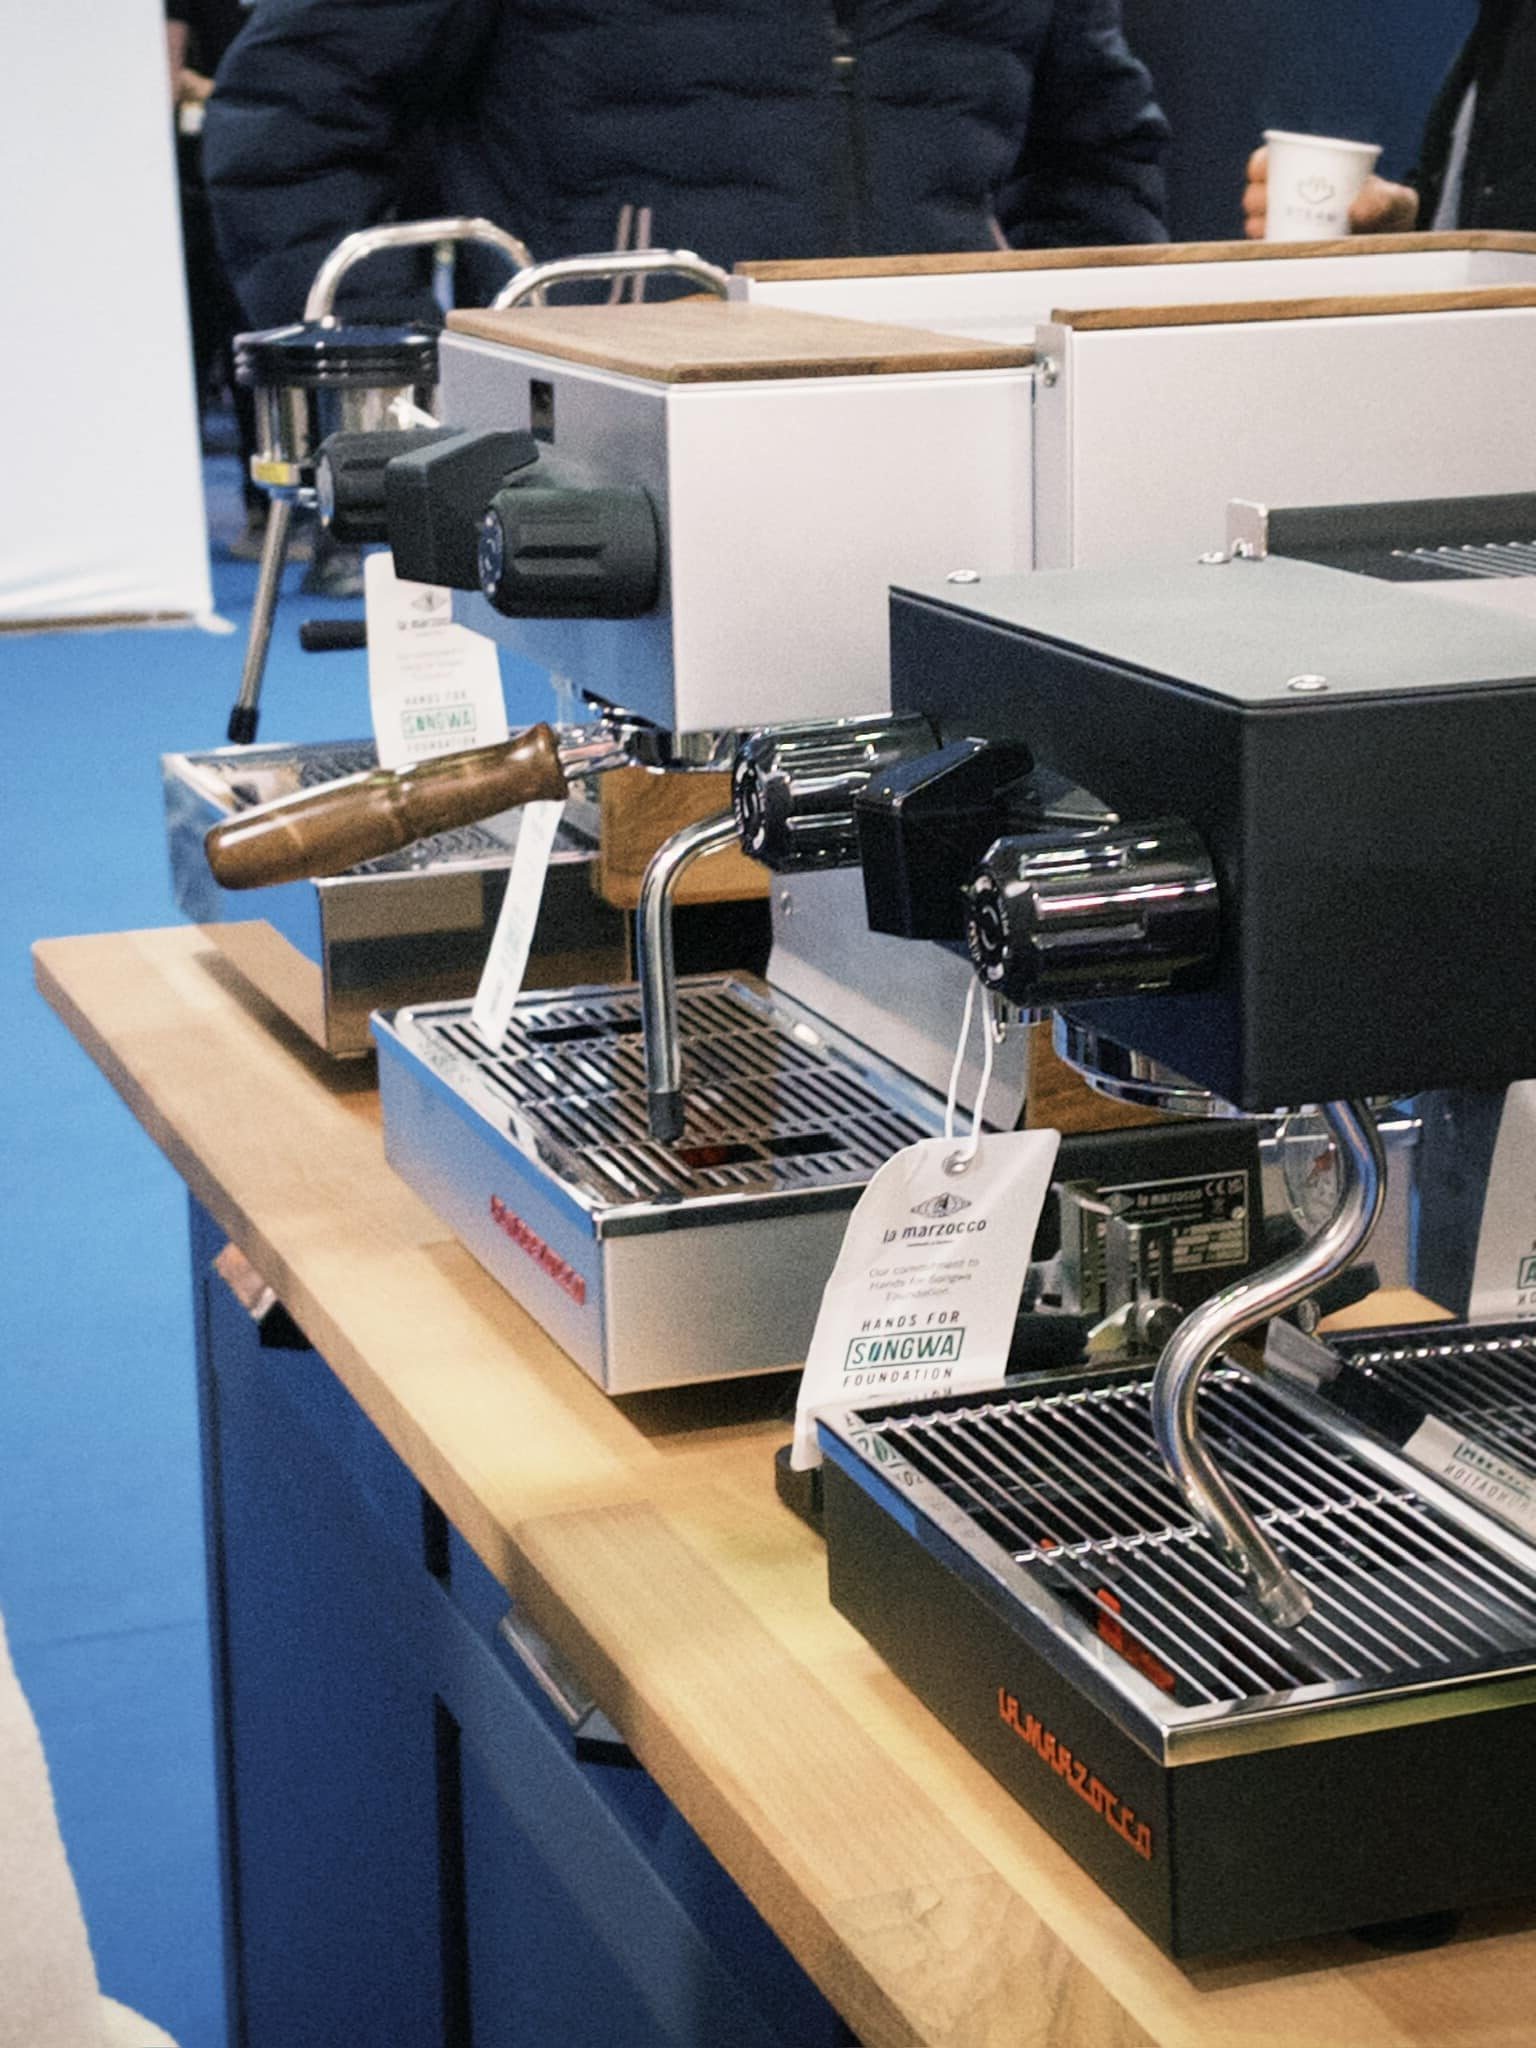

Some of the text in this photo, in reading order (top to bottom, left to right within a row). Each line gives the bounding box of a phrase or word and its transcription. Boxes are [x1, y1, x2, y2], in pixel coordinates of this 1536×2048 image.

[882, 1229, 897, 1244] la
[902, 1219, 987, 1240] marzocco
[861, 1310, 961, 1332] HANDS FOR
[852, 1334, 955, 1365] SONGWA
[843, 1367, 953, 1387] FOUNDATION
